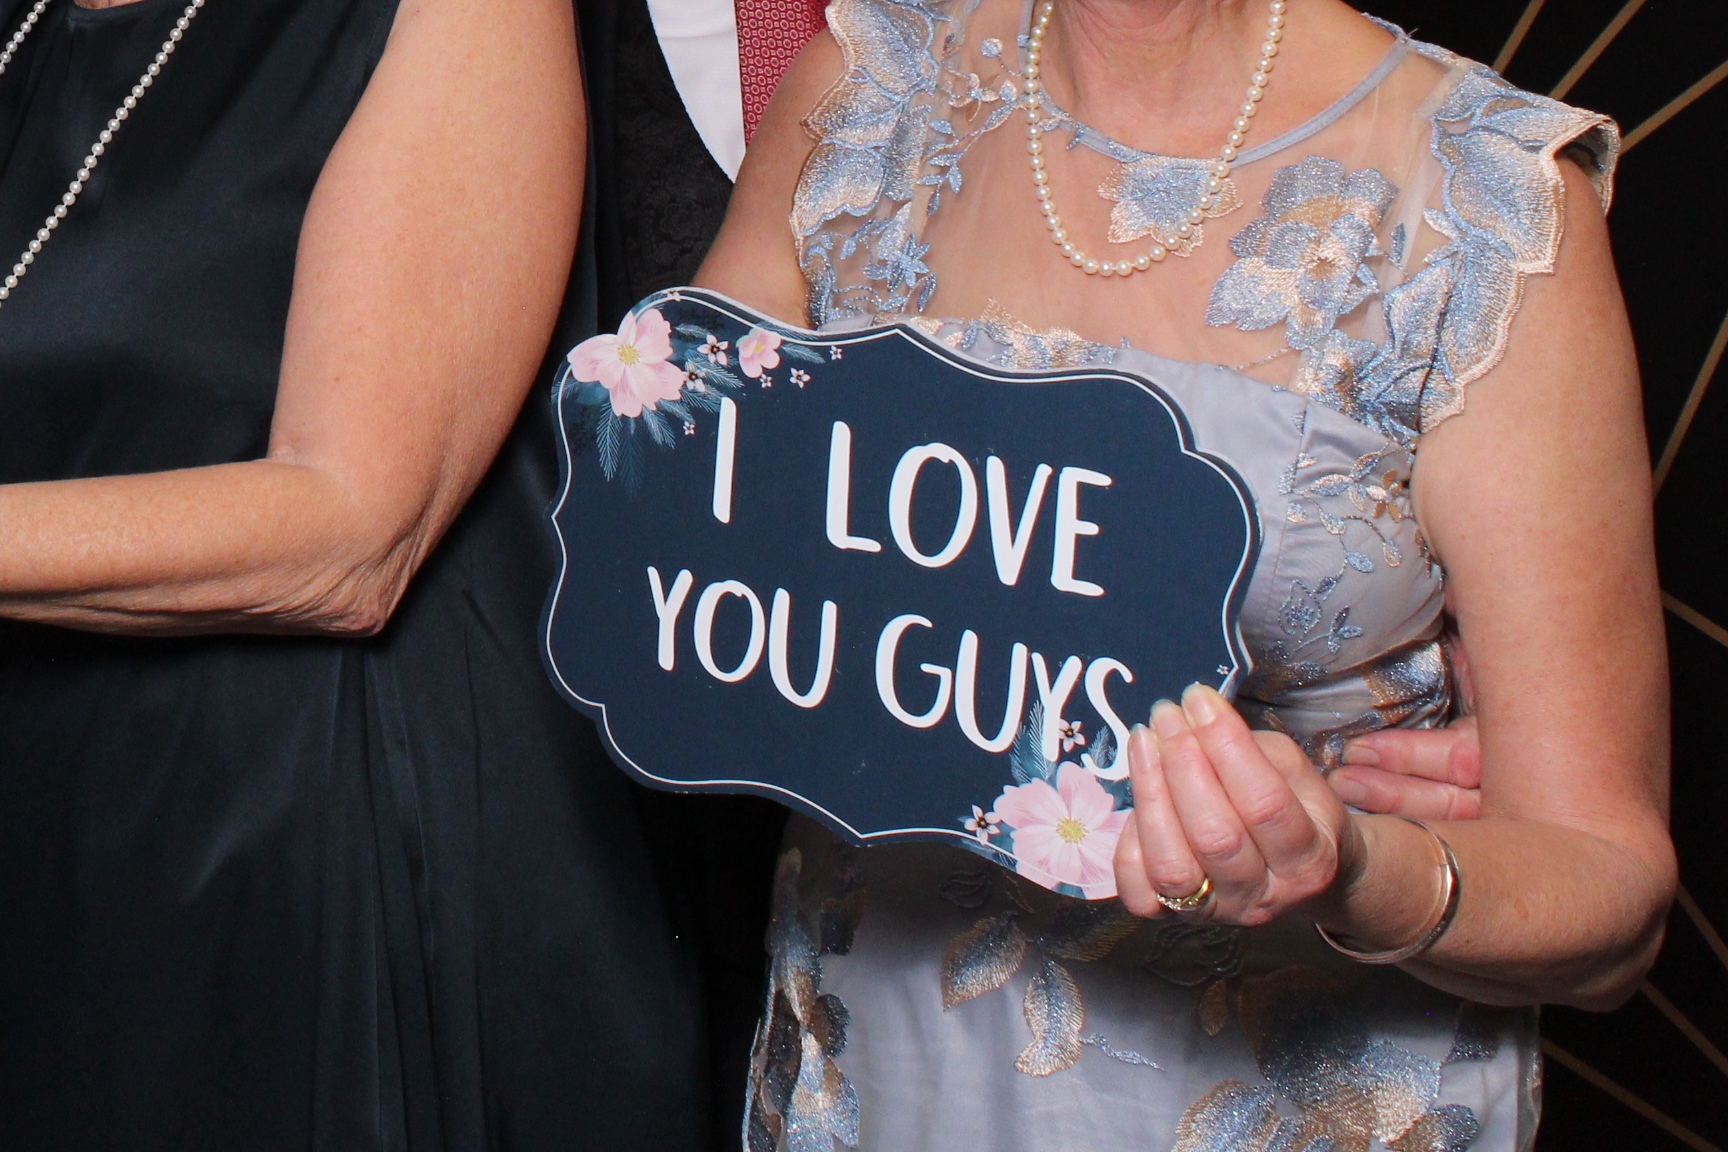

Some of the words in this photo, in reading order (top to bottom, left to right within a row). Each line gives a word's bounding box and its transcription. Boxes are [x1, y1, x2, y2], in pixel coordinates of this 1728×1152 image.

[712, 397, 737, 524] I
[825, 420, 1113, 597] LOVE
[646, 565, 838, 708] YOU
[874, 613, 1134, 781] GUYS
